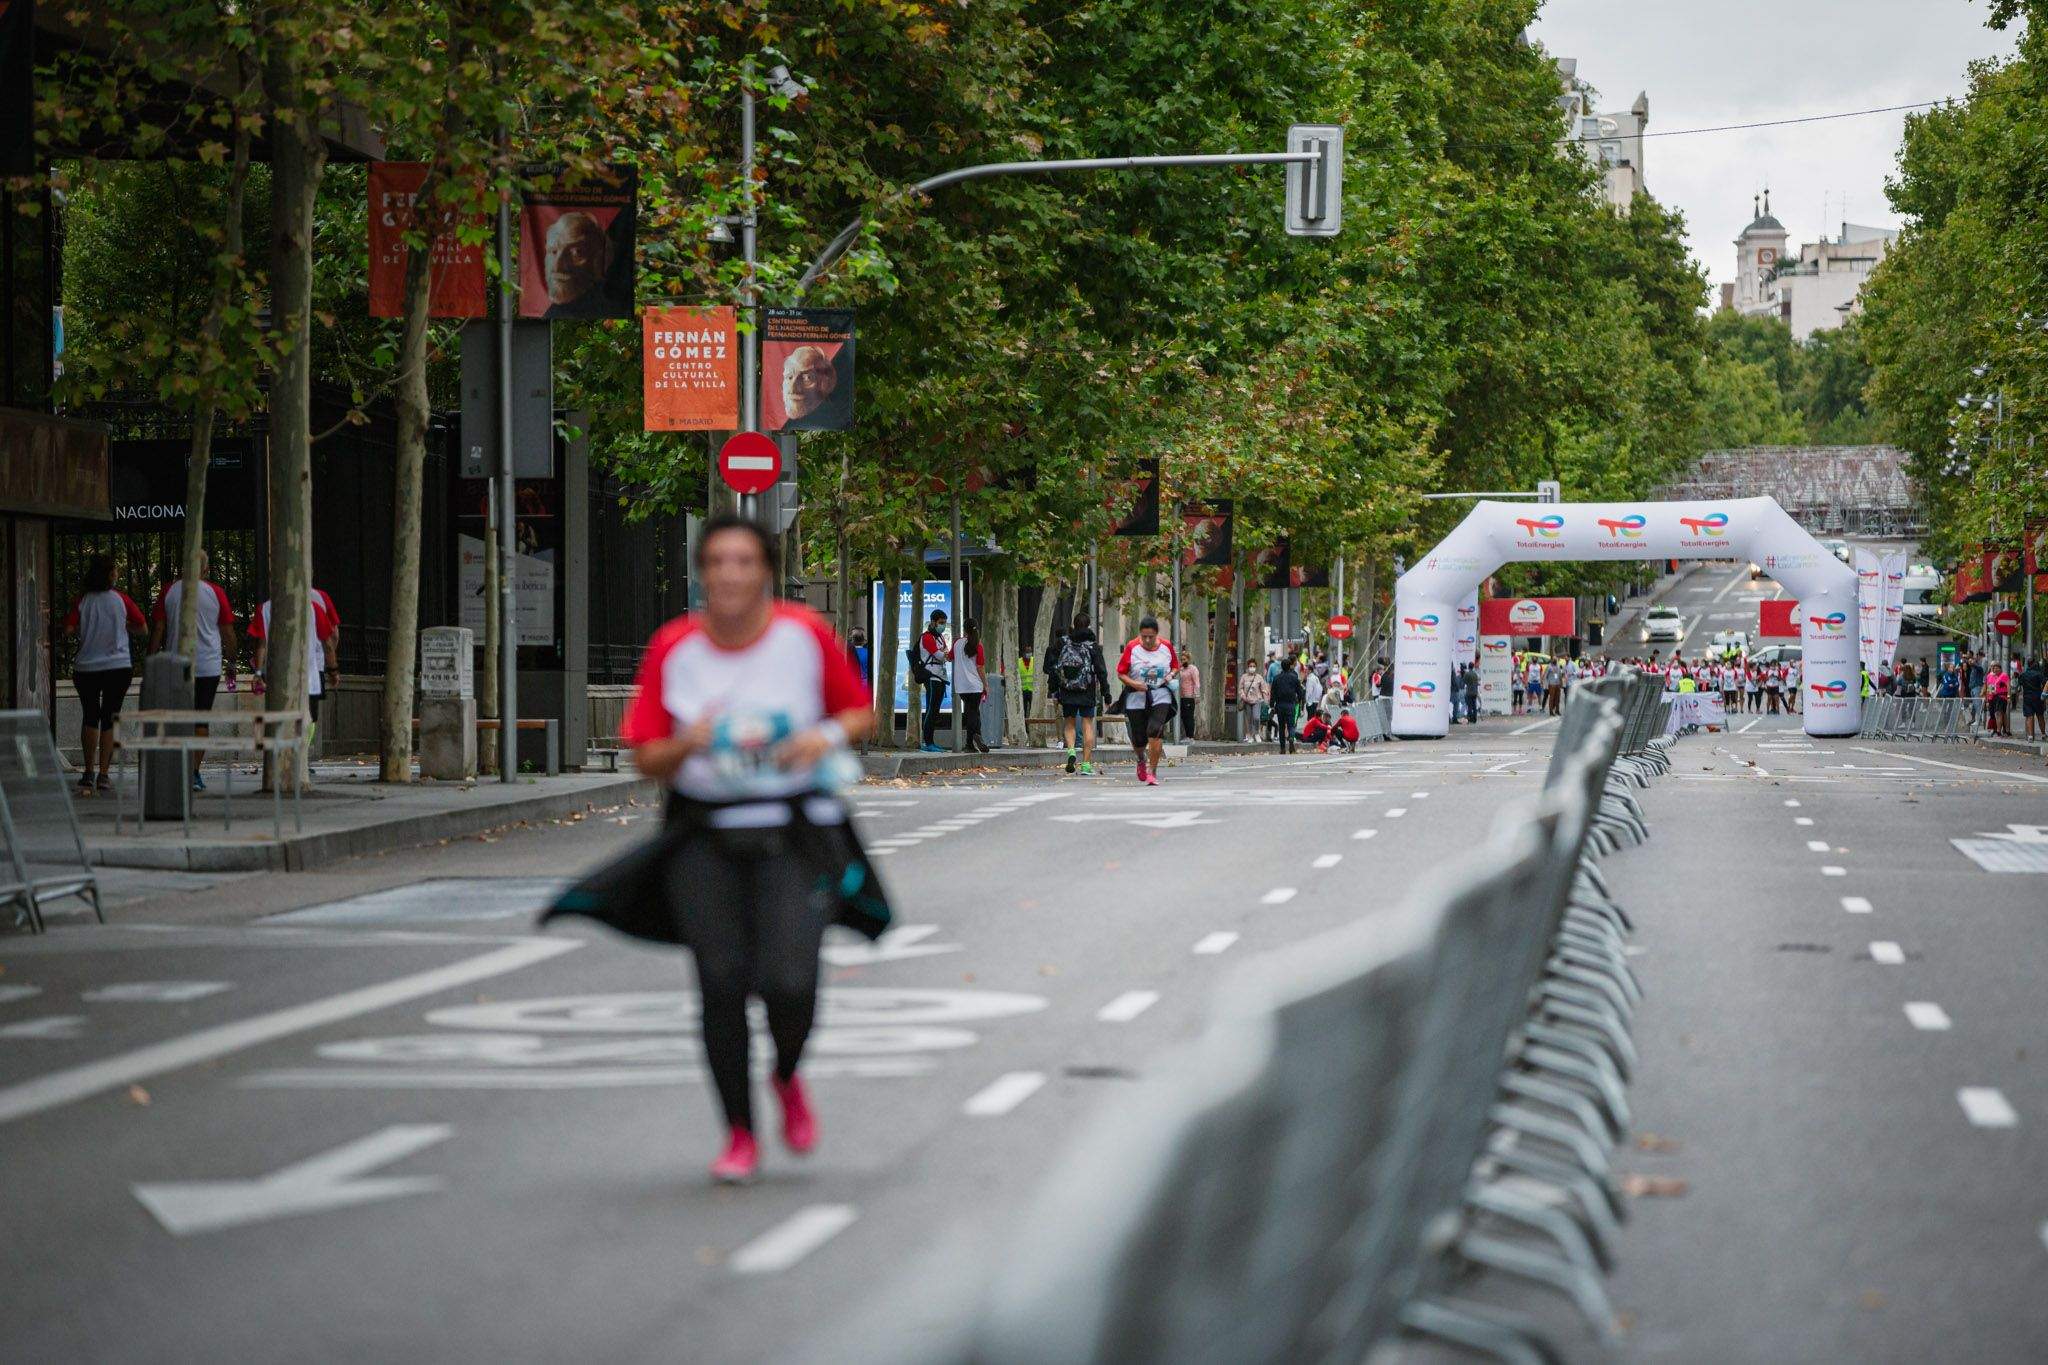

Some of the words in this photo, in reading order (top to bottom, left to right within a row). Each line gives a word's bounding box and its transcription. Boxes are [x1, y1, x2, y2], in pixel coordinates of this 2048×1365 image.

[383, 255, 399, 264] DE
[432, 255, 472, 264] VILLA
[654, 328, 726, 344] FERNÁN
[654, 343, 726, 359] GÓMEZ
[669, 362, 712, 370] CENTRO
[662, 371, 719, 379] CULTURAL
[115, 504, 188, 519] NACIONA
[1517, 541, 1565, 549] TotalEnergies
[1598, 541, 1647, 549] TotalEnergies
[1680, 540, 1730, 548] TotalEnergies
